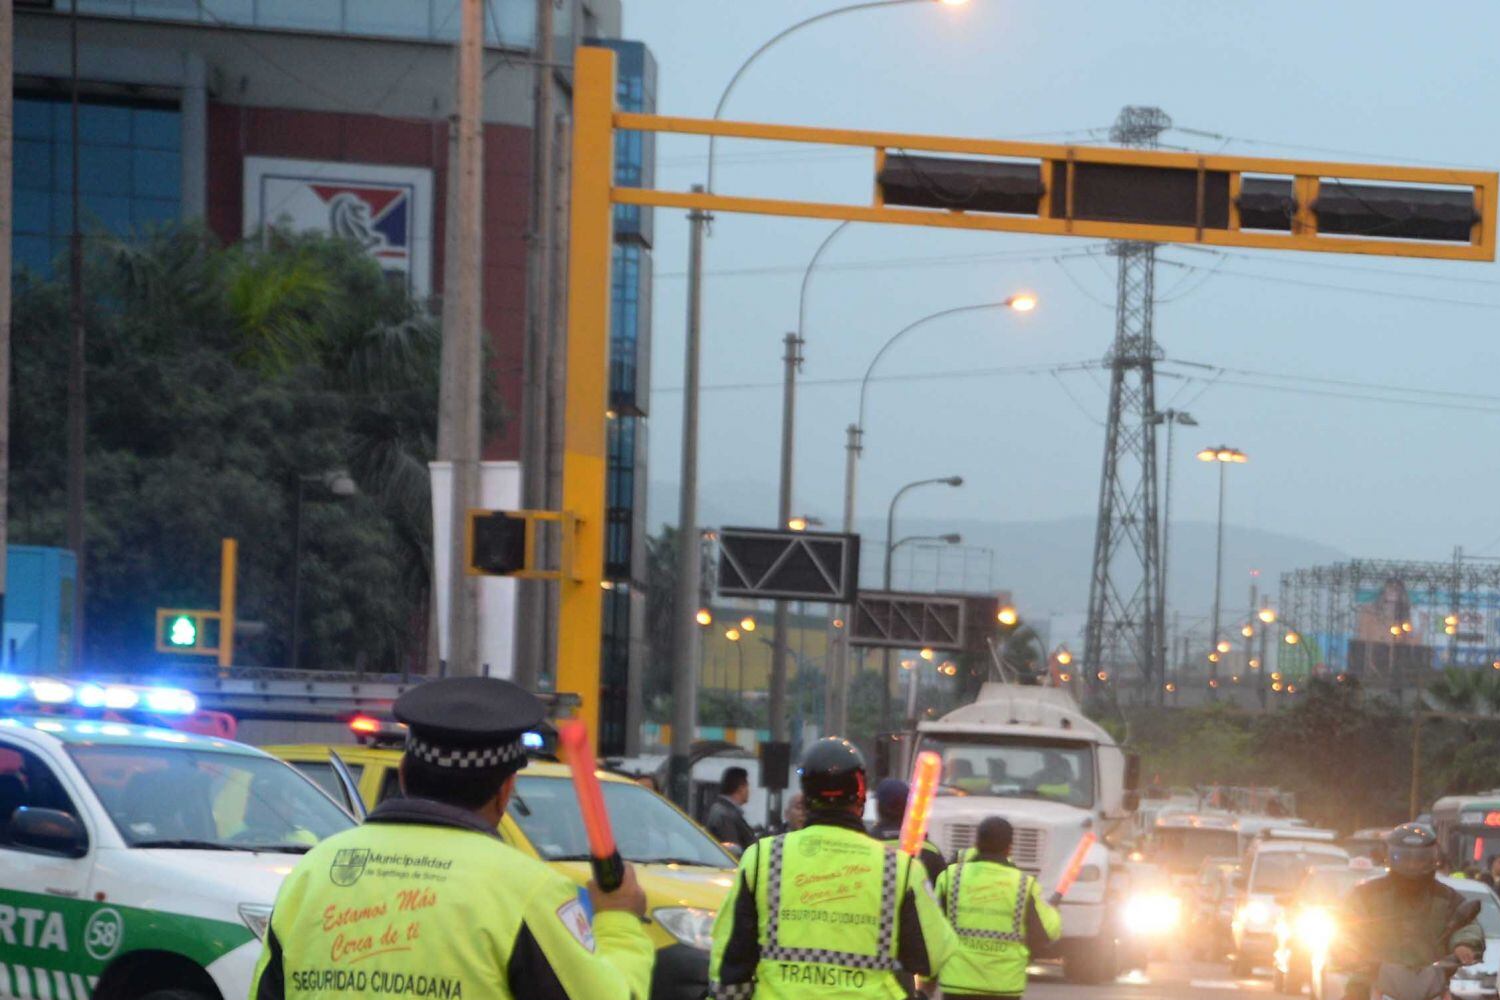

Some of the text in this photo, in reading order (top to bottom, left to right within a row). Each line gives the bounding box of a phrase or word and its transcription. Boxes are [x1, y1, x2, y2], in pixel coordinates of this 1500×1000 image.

[368, 853, 452, 870] Municipalidad
[322, 886, 437, 931] Estamos Más
[781, 909, 828, 922] SEGURIDAD
[89, 920, 116, 947] 58
[331, 931, 374, 962] Cerca
[380, 923, 399, 945] de
[292, 969, 462, 1000] SEGURIDAD CIUDADANA
[779, 964, 866, 988] TRANSITO
